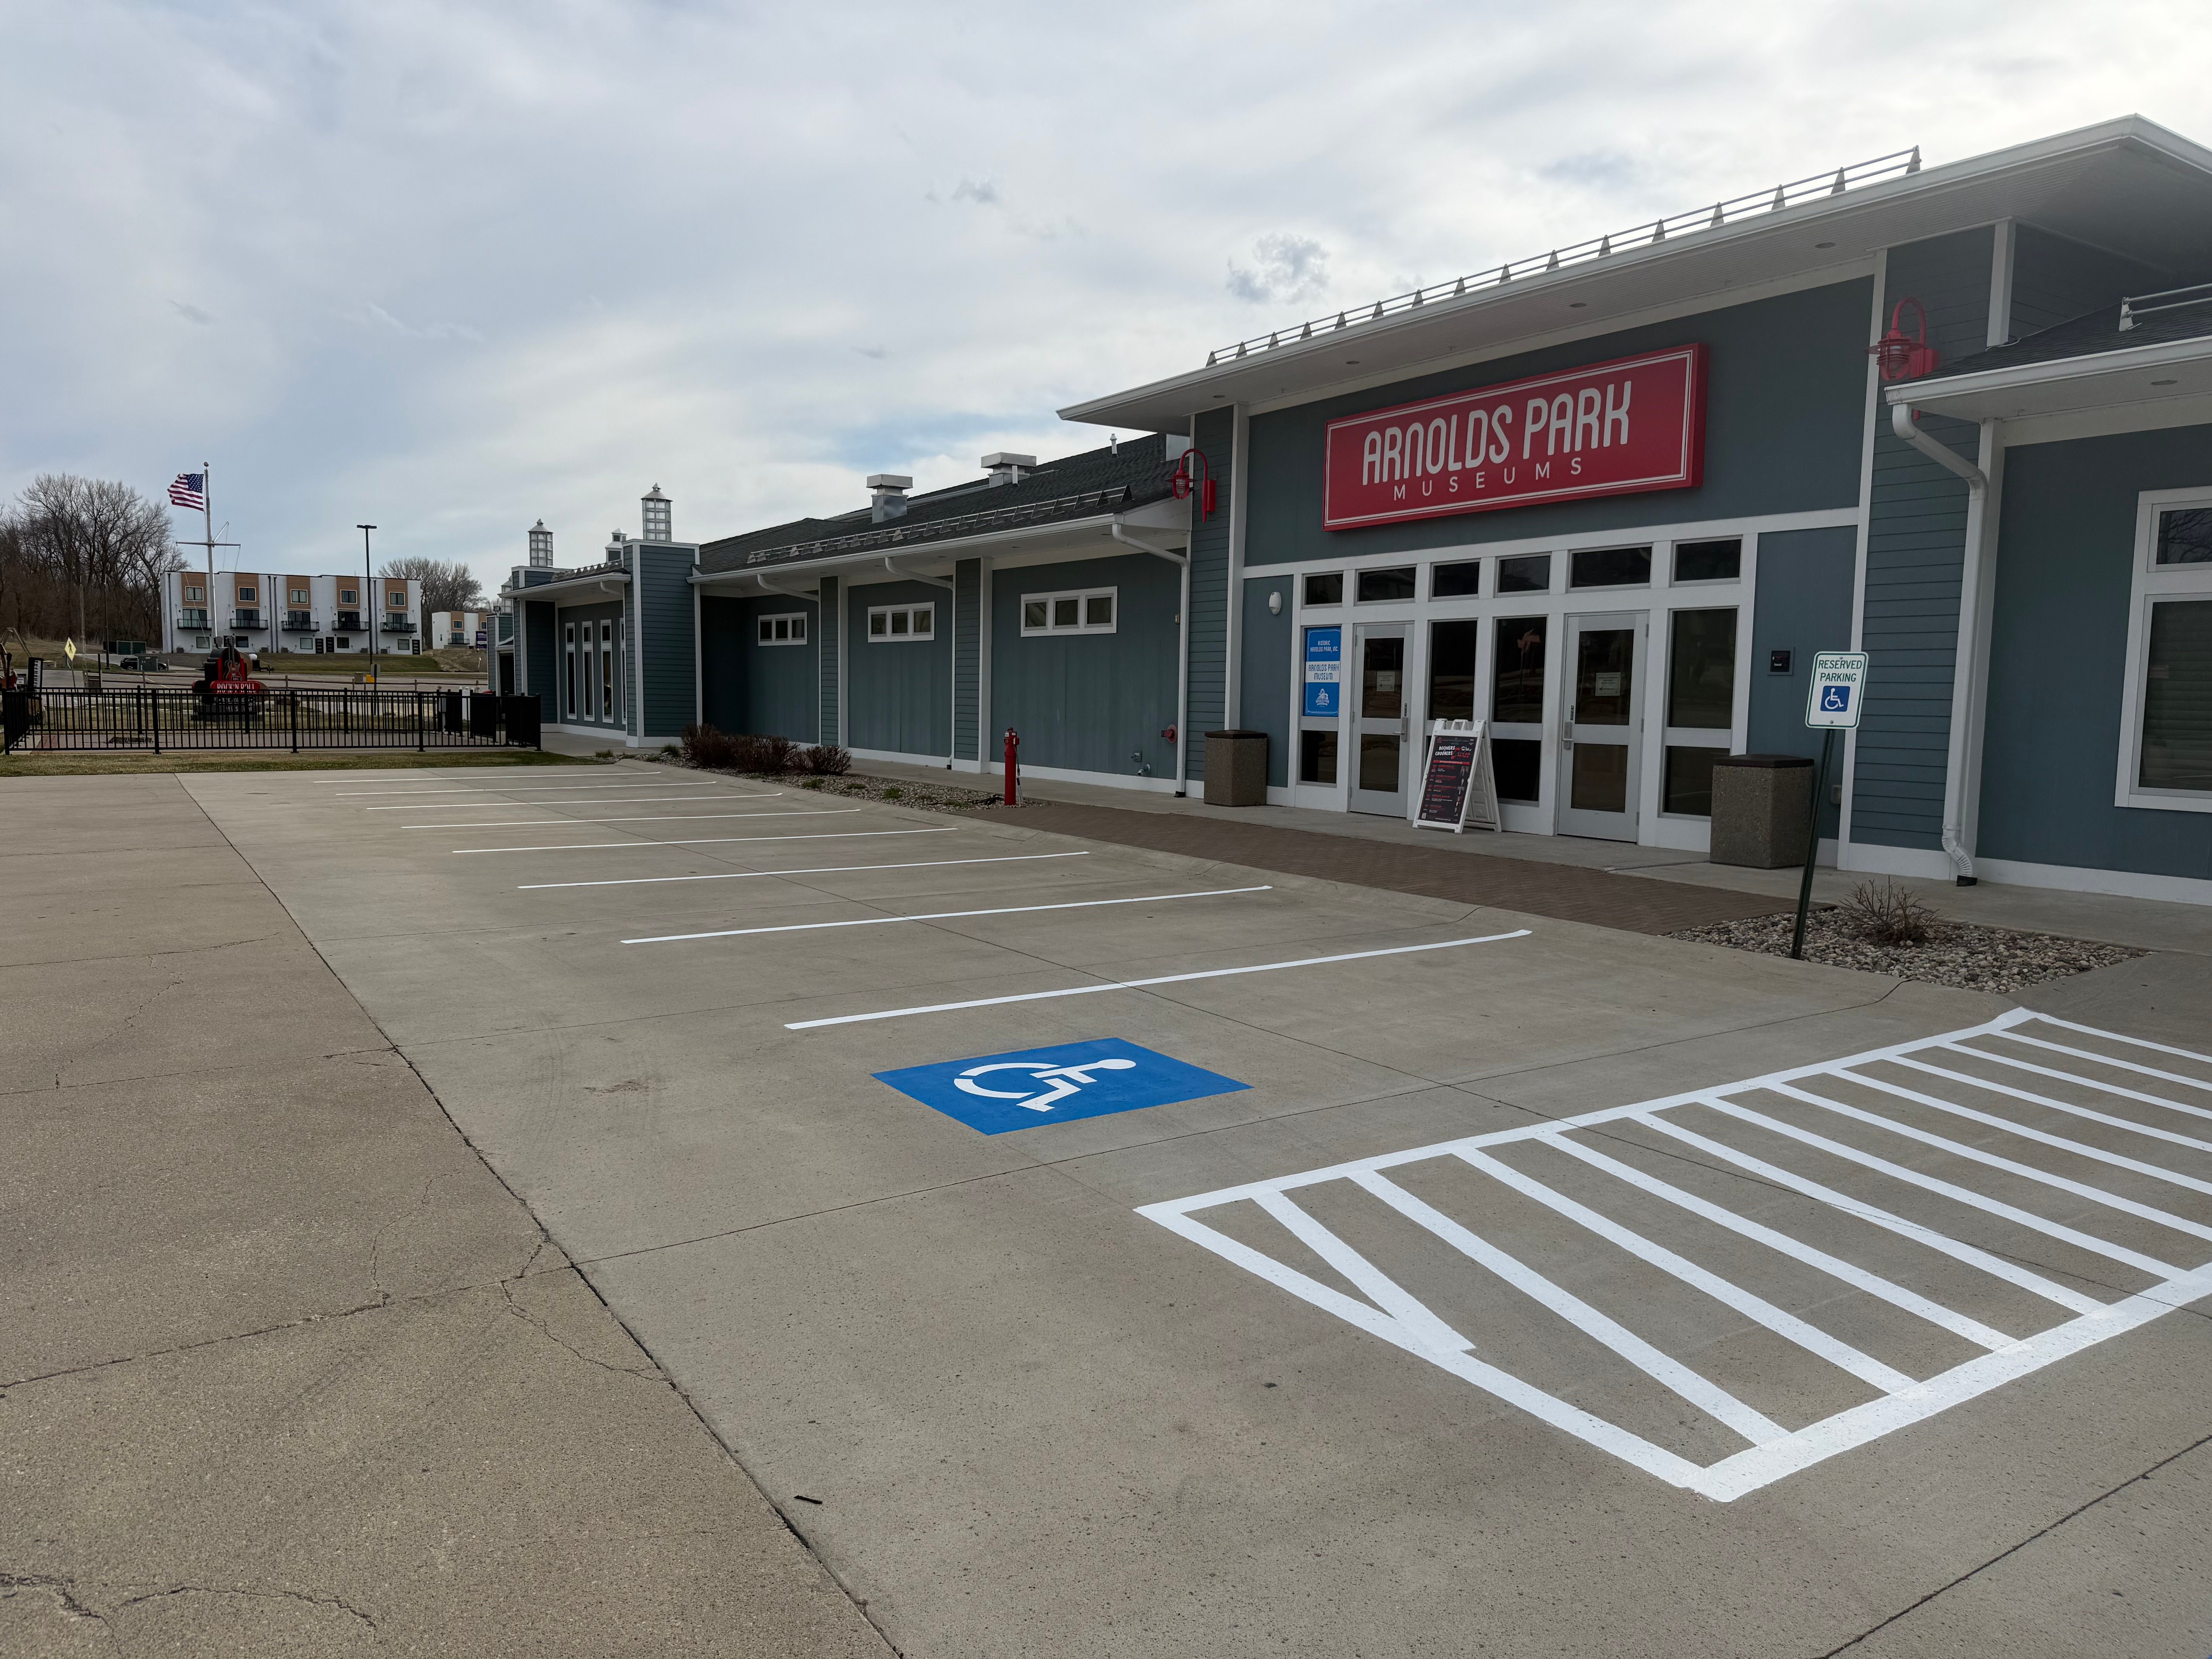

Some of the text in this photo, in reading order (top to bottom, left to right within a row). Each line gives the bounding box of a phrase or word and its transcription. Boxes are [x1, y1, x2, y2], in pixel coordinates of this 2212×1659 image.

[1362, 381, 1632, 486] ARNOLDS PARK
[1394, 457, 1582, 501] MUSEUMS
[1818, 660, 1862, 669] RESERVED
[1820, 673, 1856, 682] PARKING
